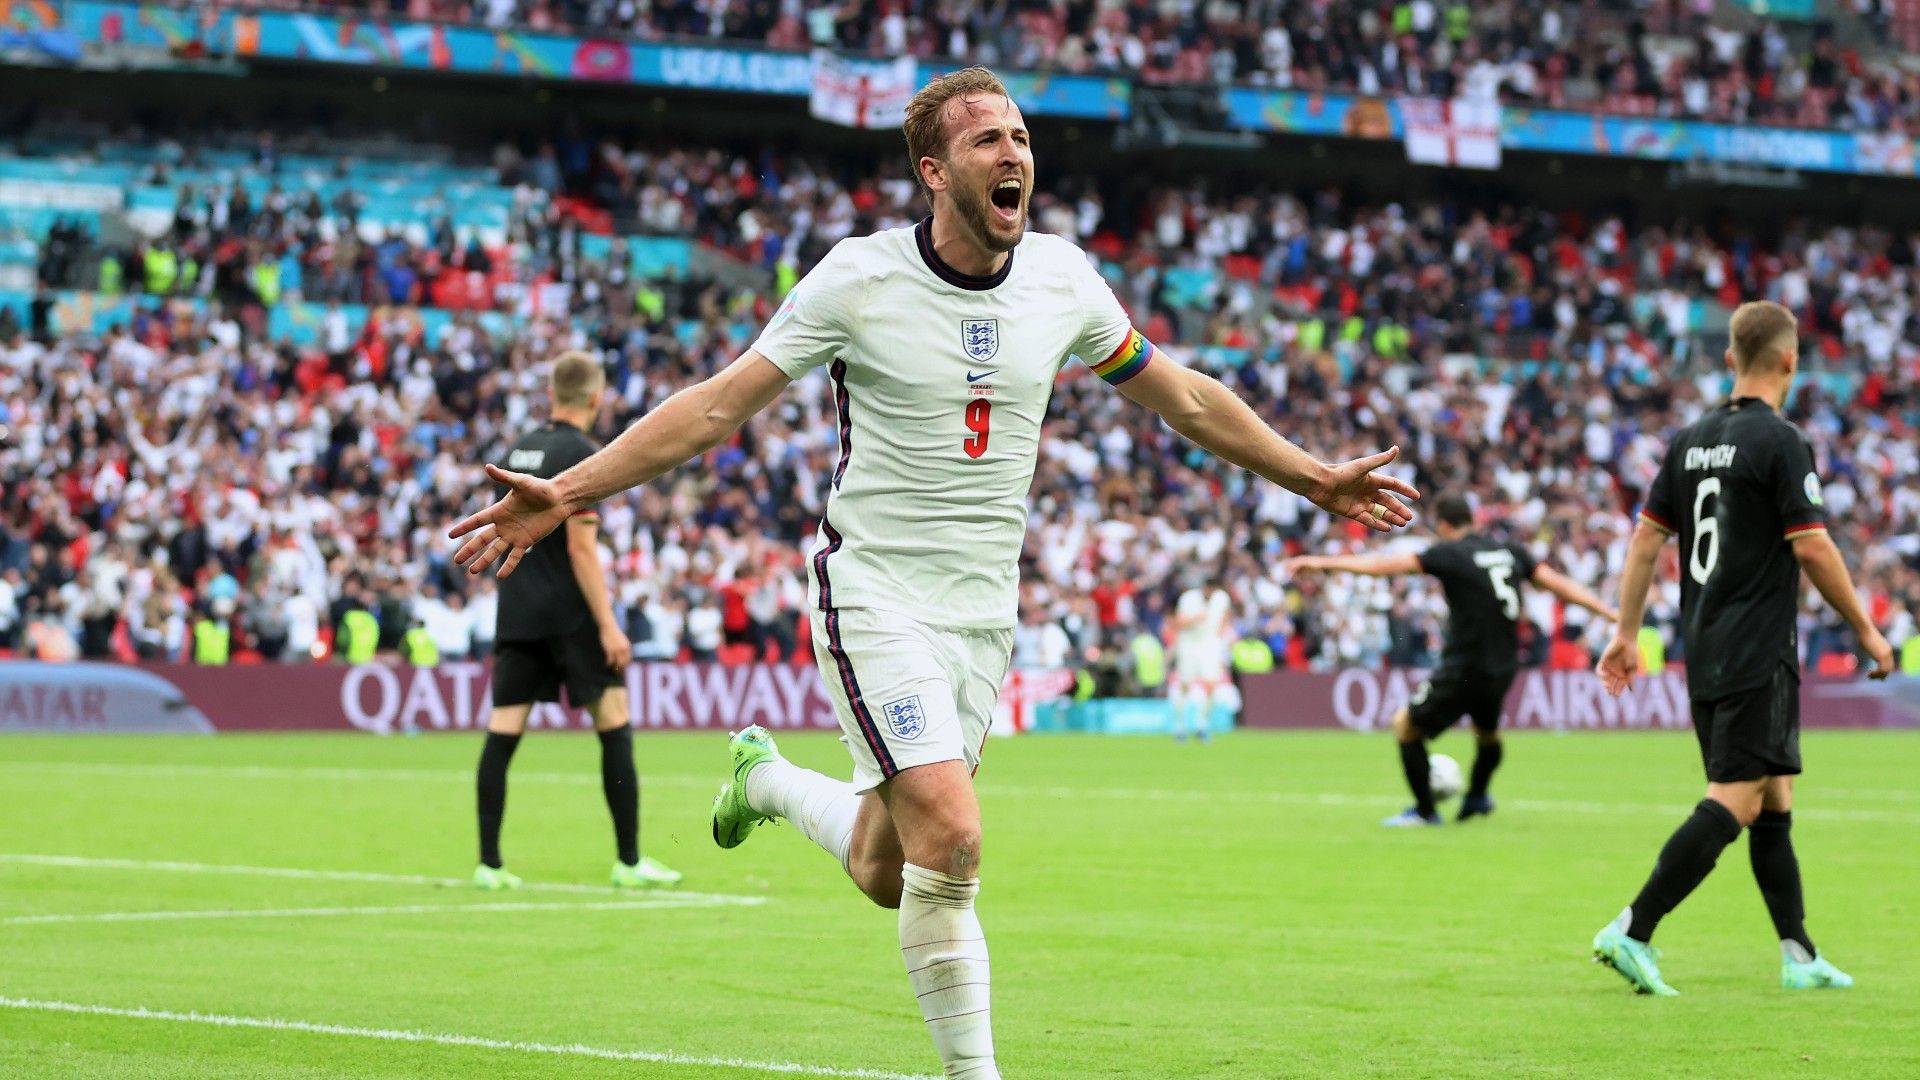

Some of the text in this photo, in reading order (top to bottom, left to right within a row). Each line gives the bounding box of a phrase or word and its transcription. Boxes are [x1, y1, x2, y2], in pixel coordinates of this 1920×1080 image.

[661, 48, 744, 88] UEFA
[749, 54, 815, 94] EUR
[964, 398, 992, 459] 9
[1690, 476, 1721, 586] 6
[1488, 565, 1520, 621] 5
[0, 682, 108, 727] ATAR
[582, 662, 838, 728] IRWAYS
[1516, 670, 1690, 730] AIRWAY
